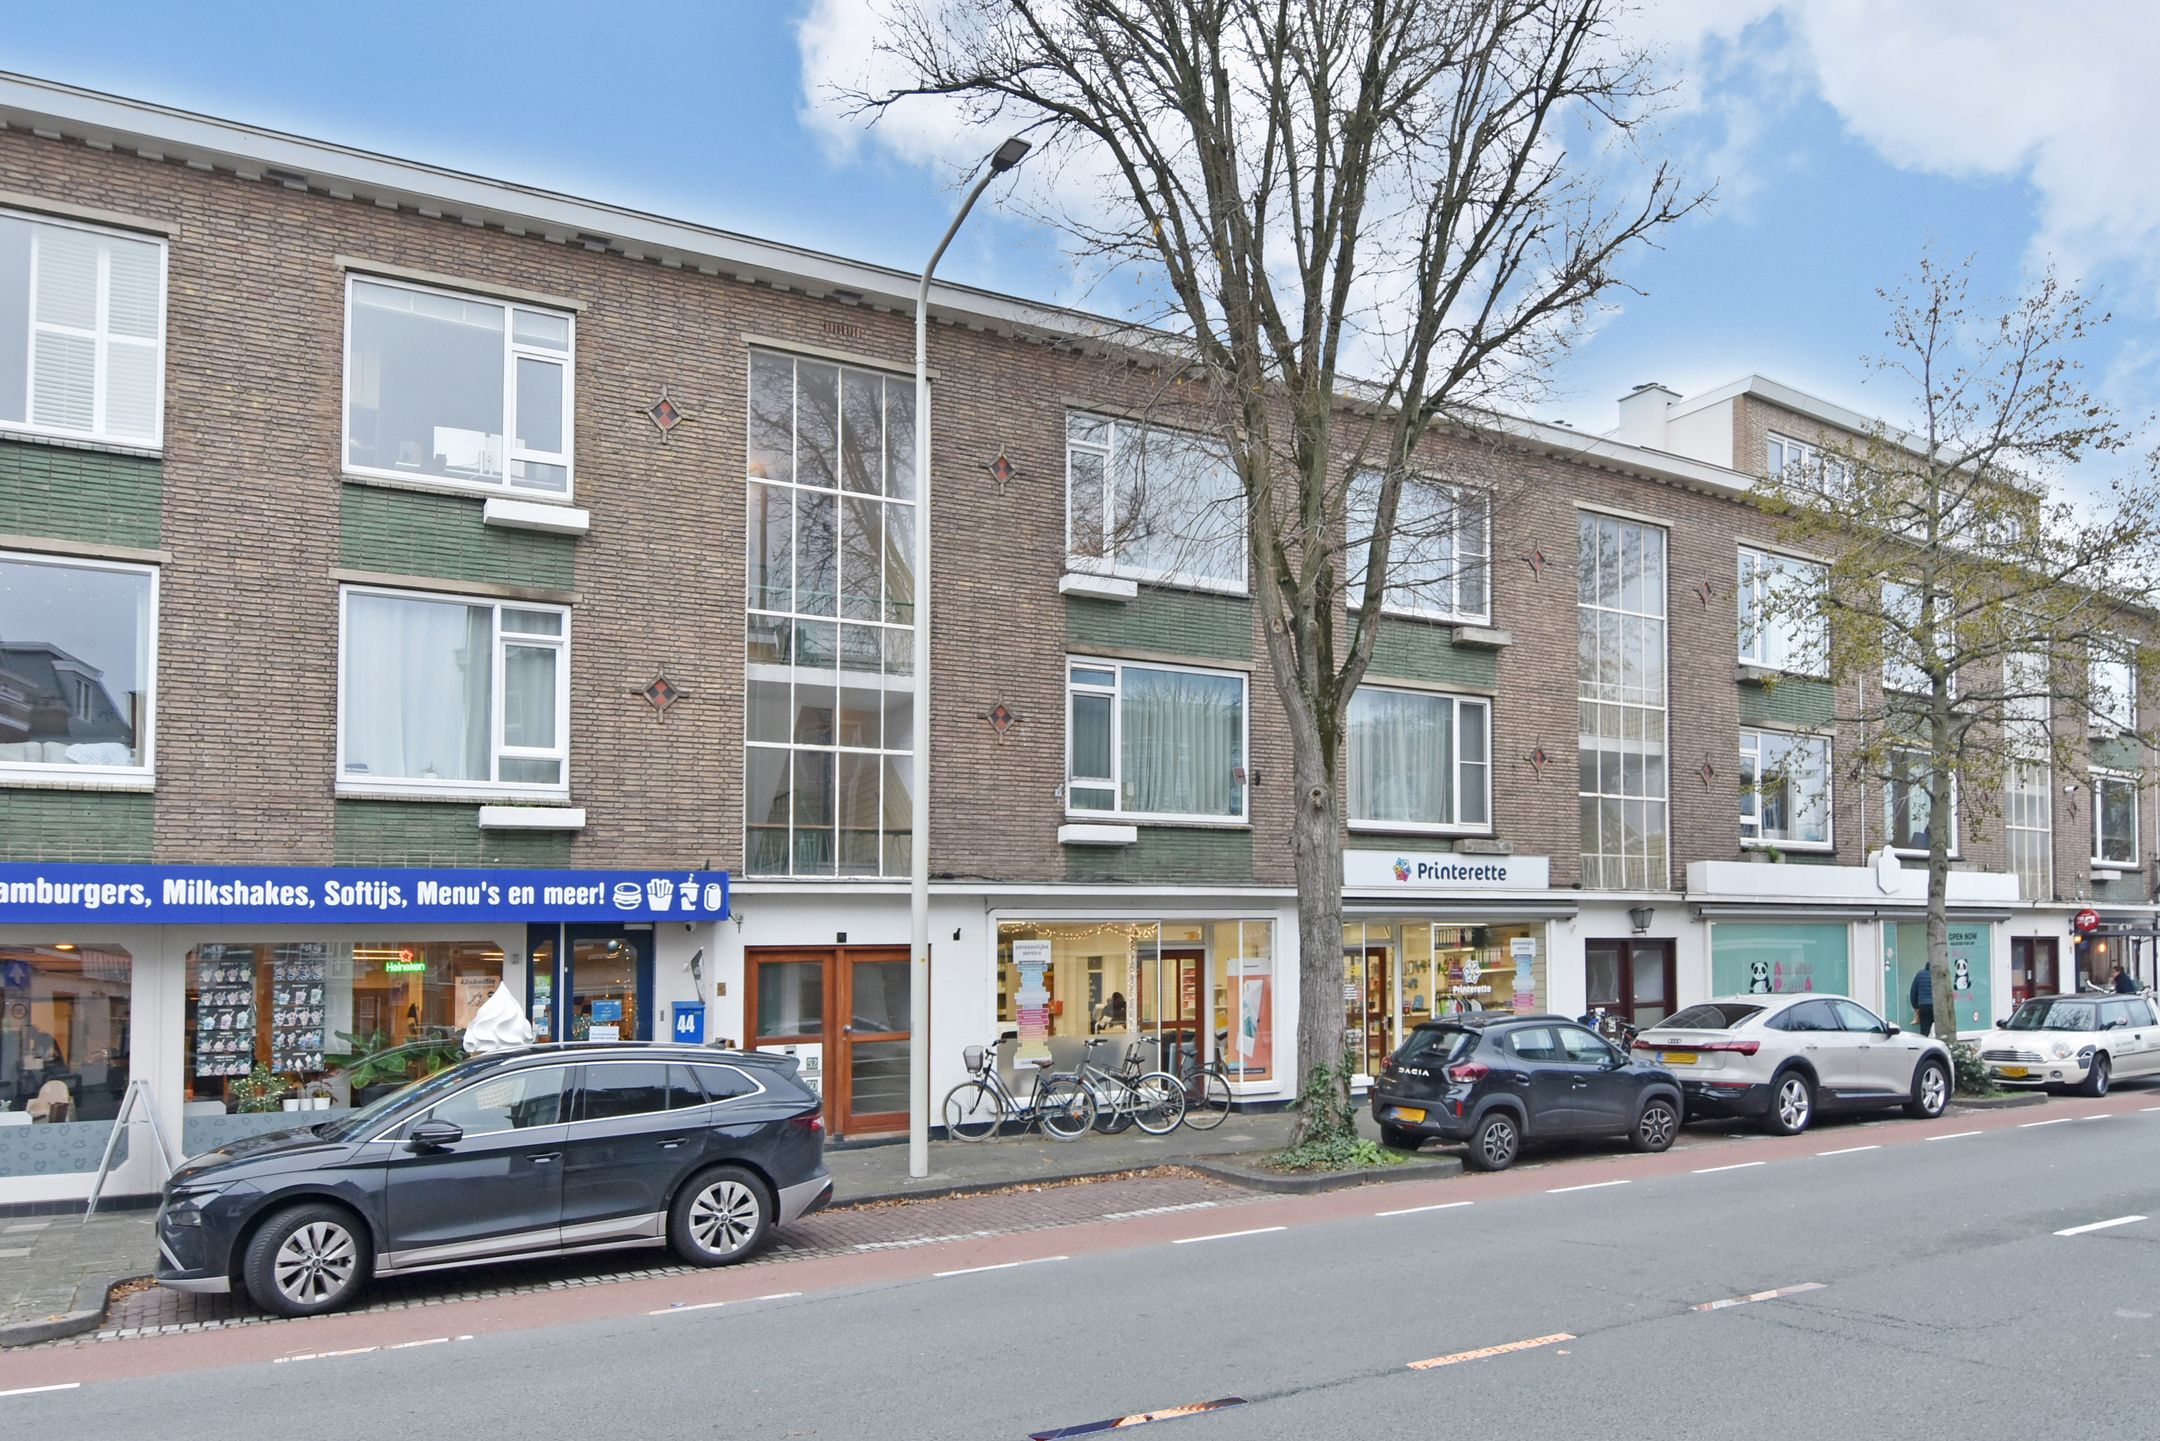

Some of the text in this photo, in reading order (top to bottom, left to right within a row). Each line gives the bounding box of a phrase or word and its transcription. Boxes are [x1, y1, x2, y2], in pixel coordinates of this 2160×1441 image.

[1418, 861, 1507, 881] Printerette
[162, 879, 316, 909] Milkshakes,
[324, 880, 407, 910] Softijs,
[417, 881, 501, 906] Menu's
[508, 885, 535, 906] en
[543, 882, 605, 906] meer!
[1948, 932, 1978, 941] OPEN NOW
[386, 962, 426, 973] Heineken
[1453, 984, 1492, 995] Printerette
[677, 1014, 695, 1033] 44
[807, 1058, 818, 1068] 52
[1398, 1067, 1430, 1077] DACIA
